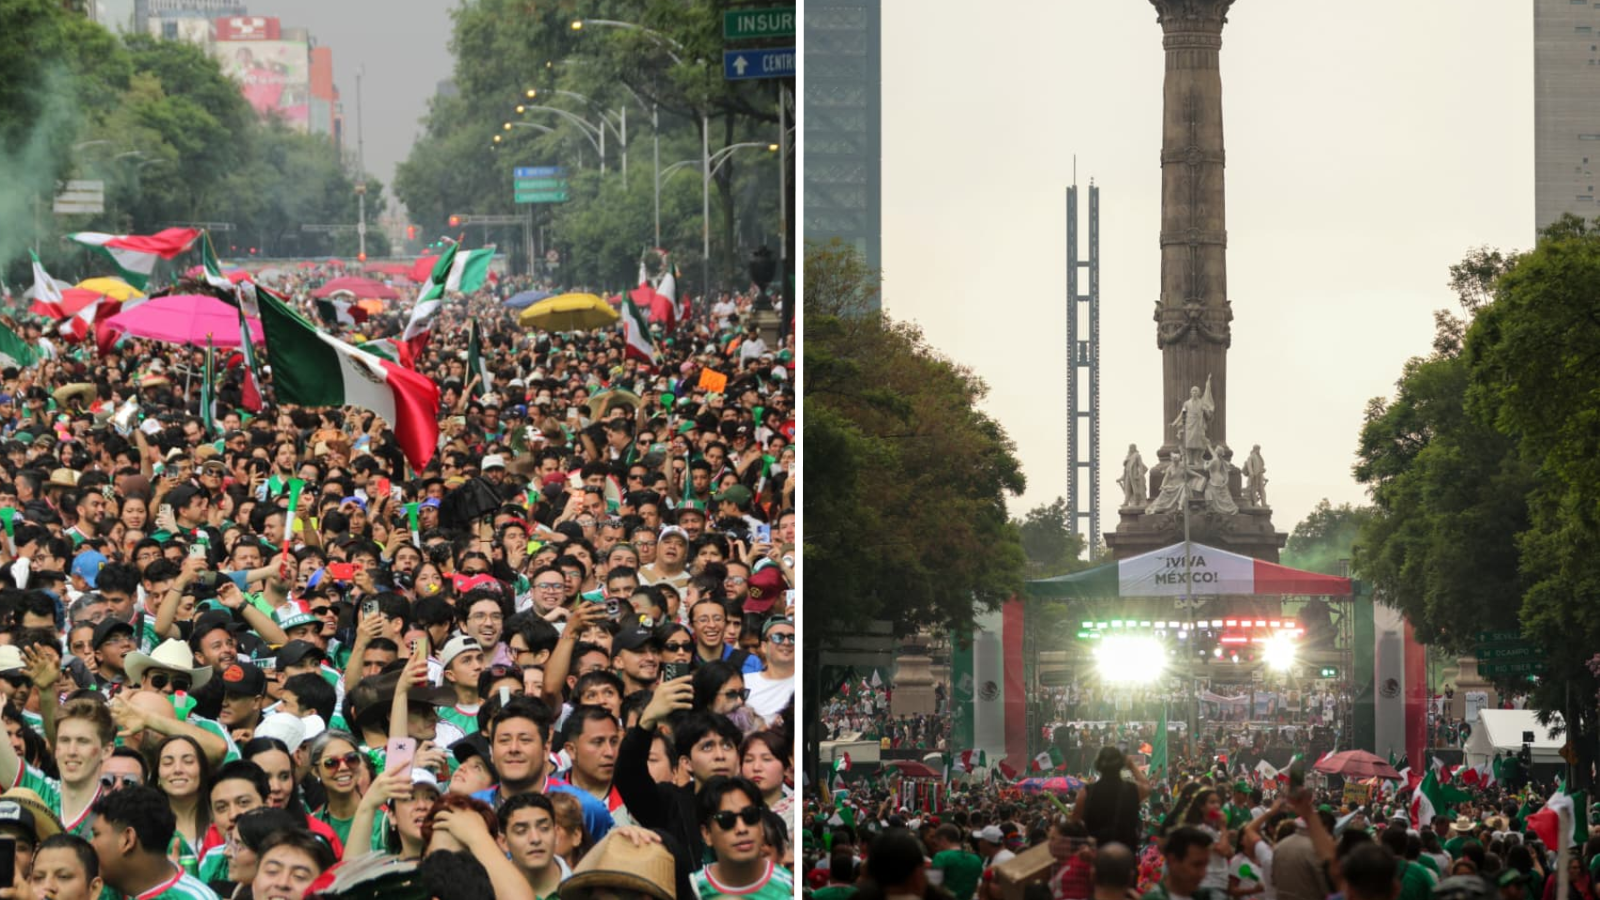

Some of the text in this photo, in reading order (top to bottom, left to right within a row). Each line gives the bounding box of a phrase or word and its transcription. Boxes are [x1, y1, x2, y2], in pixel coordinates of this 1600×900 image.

[738, 12, 796, 33] INSUR
[1155, 571, 1218, 585] MÉXCO!
[1495, 648, 1529, 656] OCAMPO
